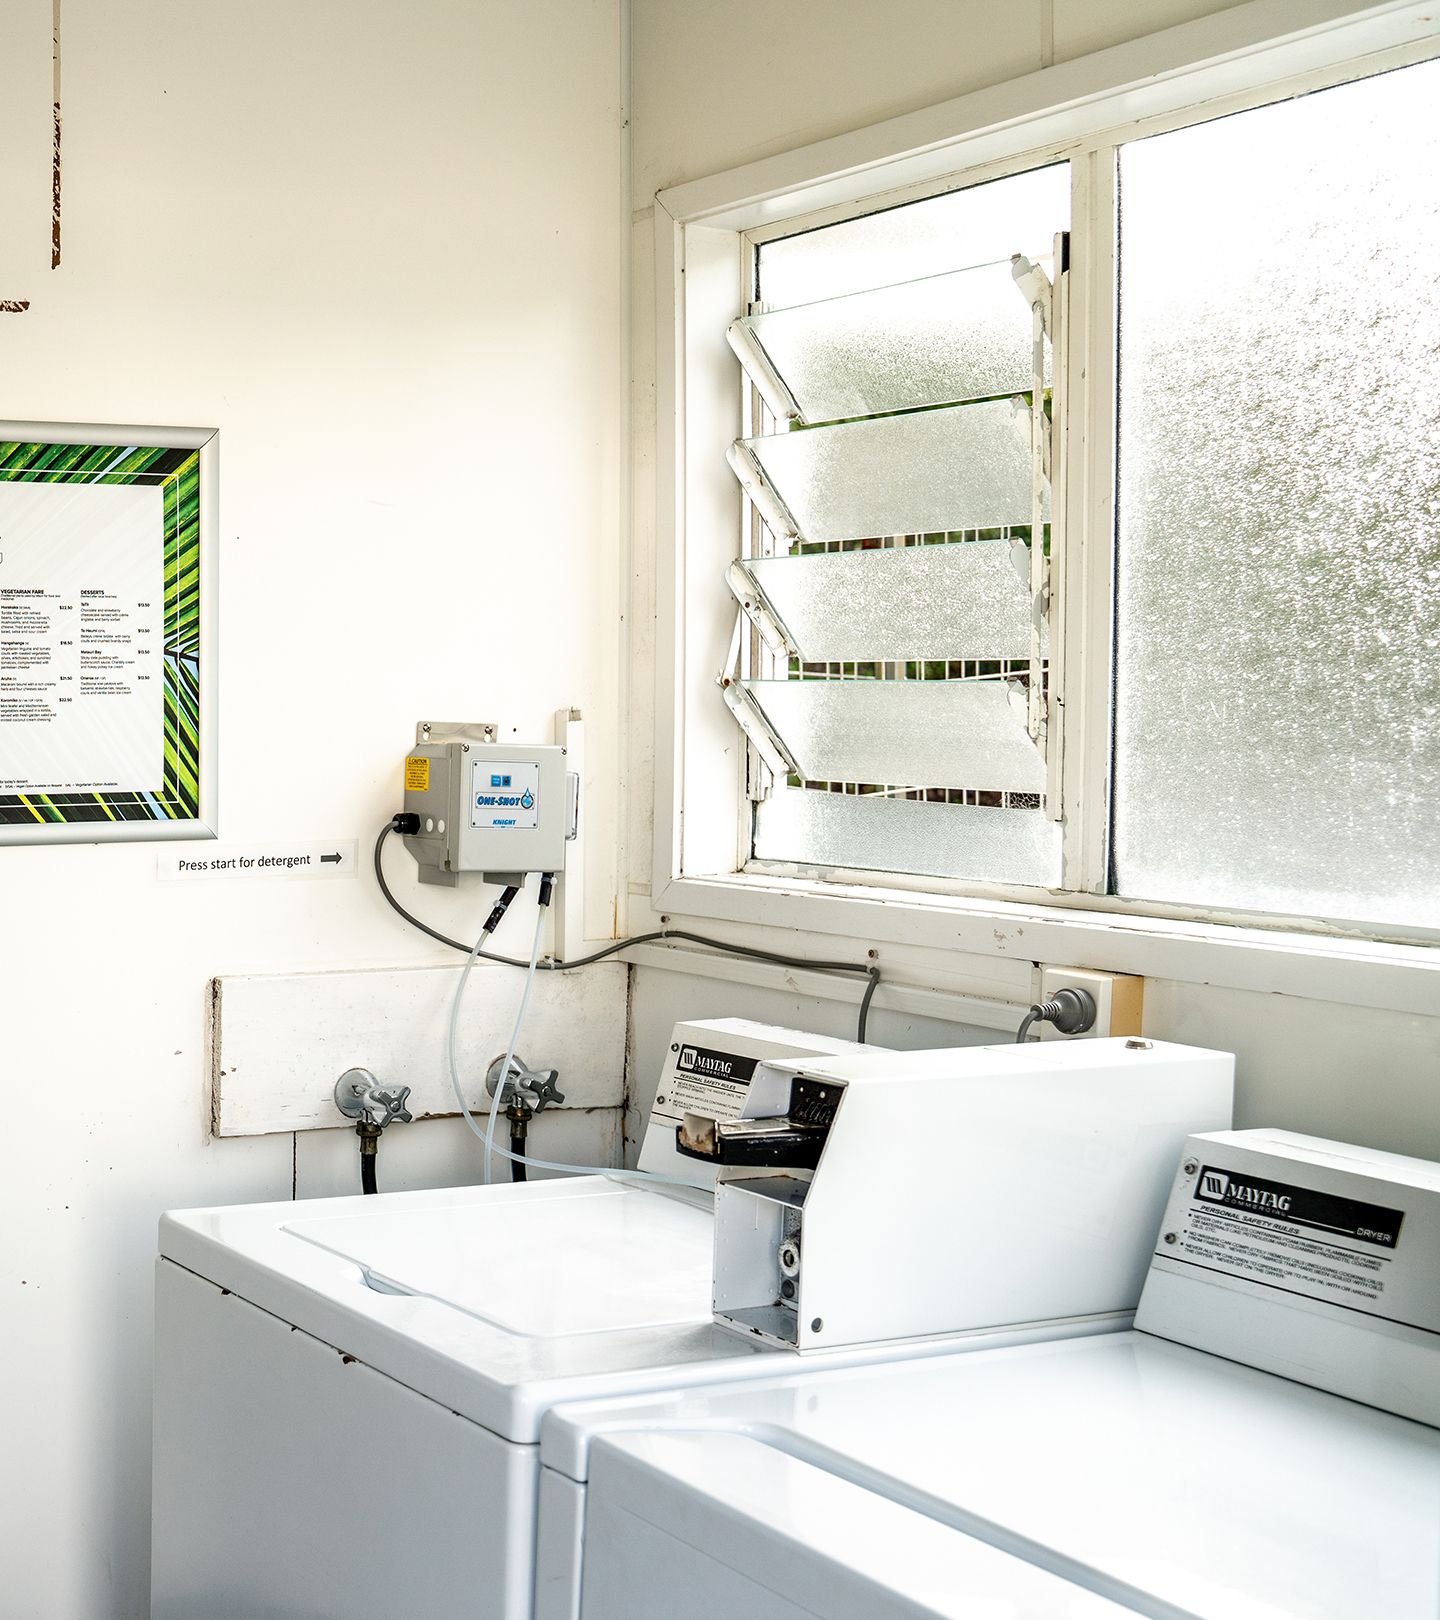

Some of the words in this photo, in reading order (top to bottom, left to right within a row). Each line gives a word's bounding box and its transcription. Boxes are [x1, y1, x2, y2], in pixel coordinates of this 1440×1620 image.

[477, 796, 520, 806] ONE-SHOT
[179, 859, 207, 870] Press
[211, 858, 235, 869] start
[239, 856, 254, 867] for
[258, 854, 310, 869] detergent
[694, 1067, 729, 1078] COMMERCIAL
[696, 1056, 732, 1073] MAYTAG
[680, 1074, 702, 1082] PERSONAL
[1226, 1183, 1292, 1211] MAYTAG
[1224, 1198, 1287, 1217] COMMERCIAL
[1200, 1205, 1240, 1220] PERSONAL
[1241, 1215, 1272, 1228] SAFETY
[1272, 1224, 1300, 1234] RULES
[1356, 1227, 1392, 1242] DRYER
